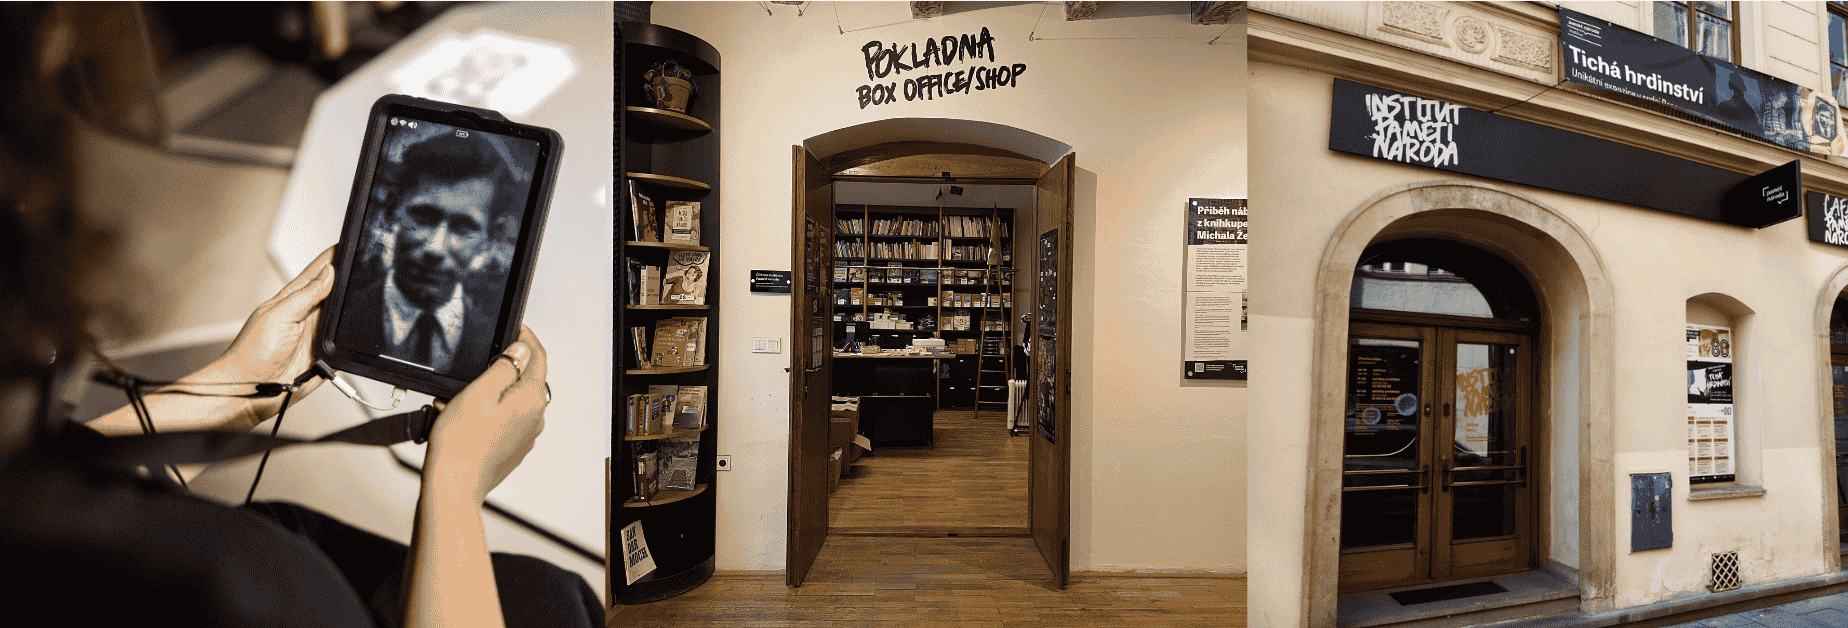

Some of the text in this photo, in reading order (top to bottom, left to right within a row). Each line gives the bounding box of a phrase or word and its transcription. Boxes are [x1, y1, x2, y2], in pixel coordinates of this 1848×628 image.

[861, 26, 996, 81] POKLADNA
[1568, 44, 1704, 105] Tichá hrdinství
[1571, 67, 1604, 88] Unikátní
[855, 63, 1027, 110] BOX OFFICE/SHOP
[1365, 93, 1466, 125] INSTITUT
[1197, 205, 1230, 215] Příběh
[1203, 218, 1248, 229] knihkupe
[1196, 229, 1248, 240] Michala Že
[1710, 338, 1730, 358] 80
